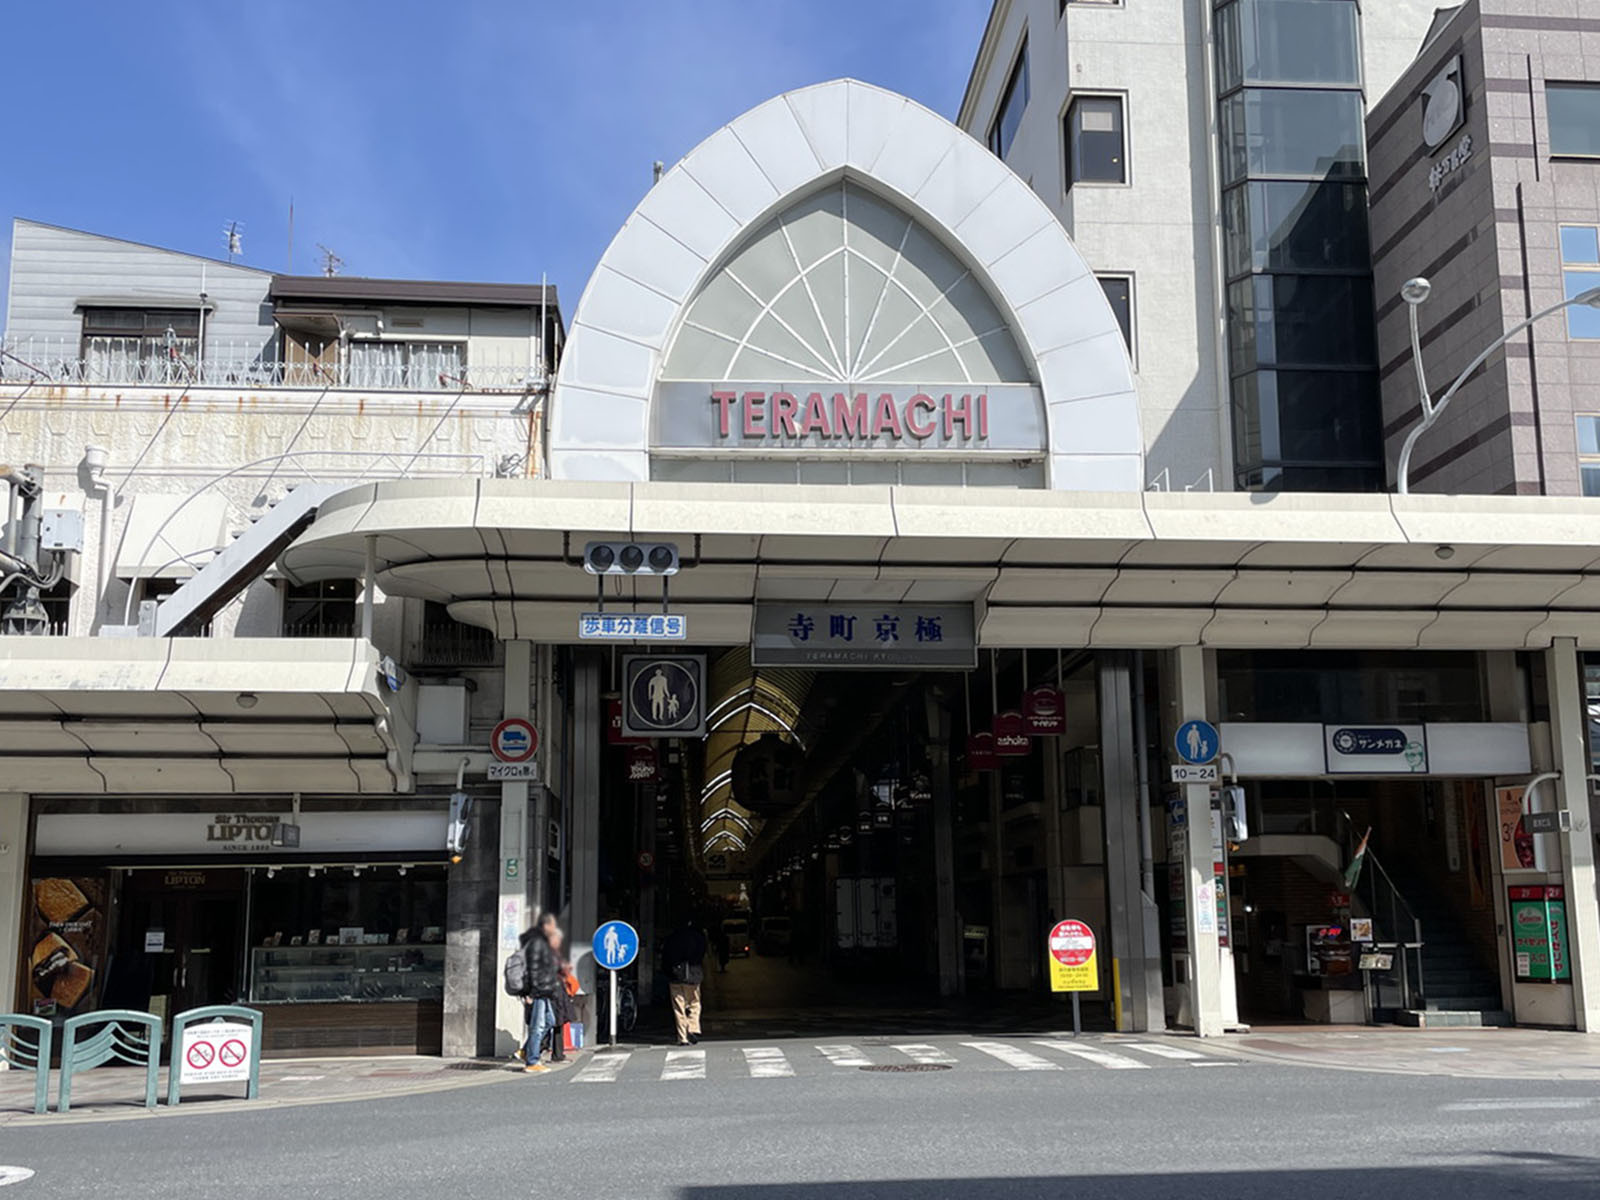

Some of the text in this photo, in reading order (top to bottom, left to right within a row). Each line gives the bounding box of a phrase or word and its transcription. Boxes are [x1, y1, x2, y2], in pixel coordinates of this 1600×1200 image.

[711, 390, 989, 441] TERAMACHI
[584, 616, 681, 635] 歩車分離信号
[787, 612, 943, 643] 寺町京極
[1358, 738, 1404, 749] サンメガネ
[206, 824, 272, 841] LIPTO
[1548, 887, 1560, 898] 2F
